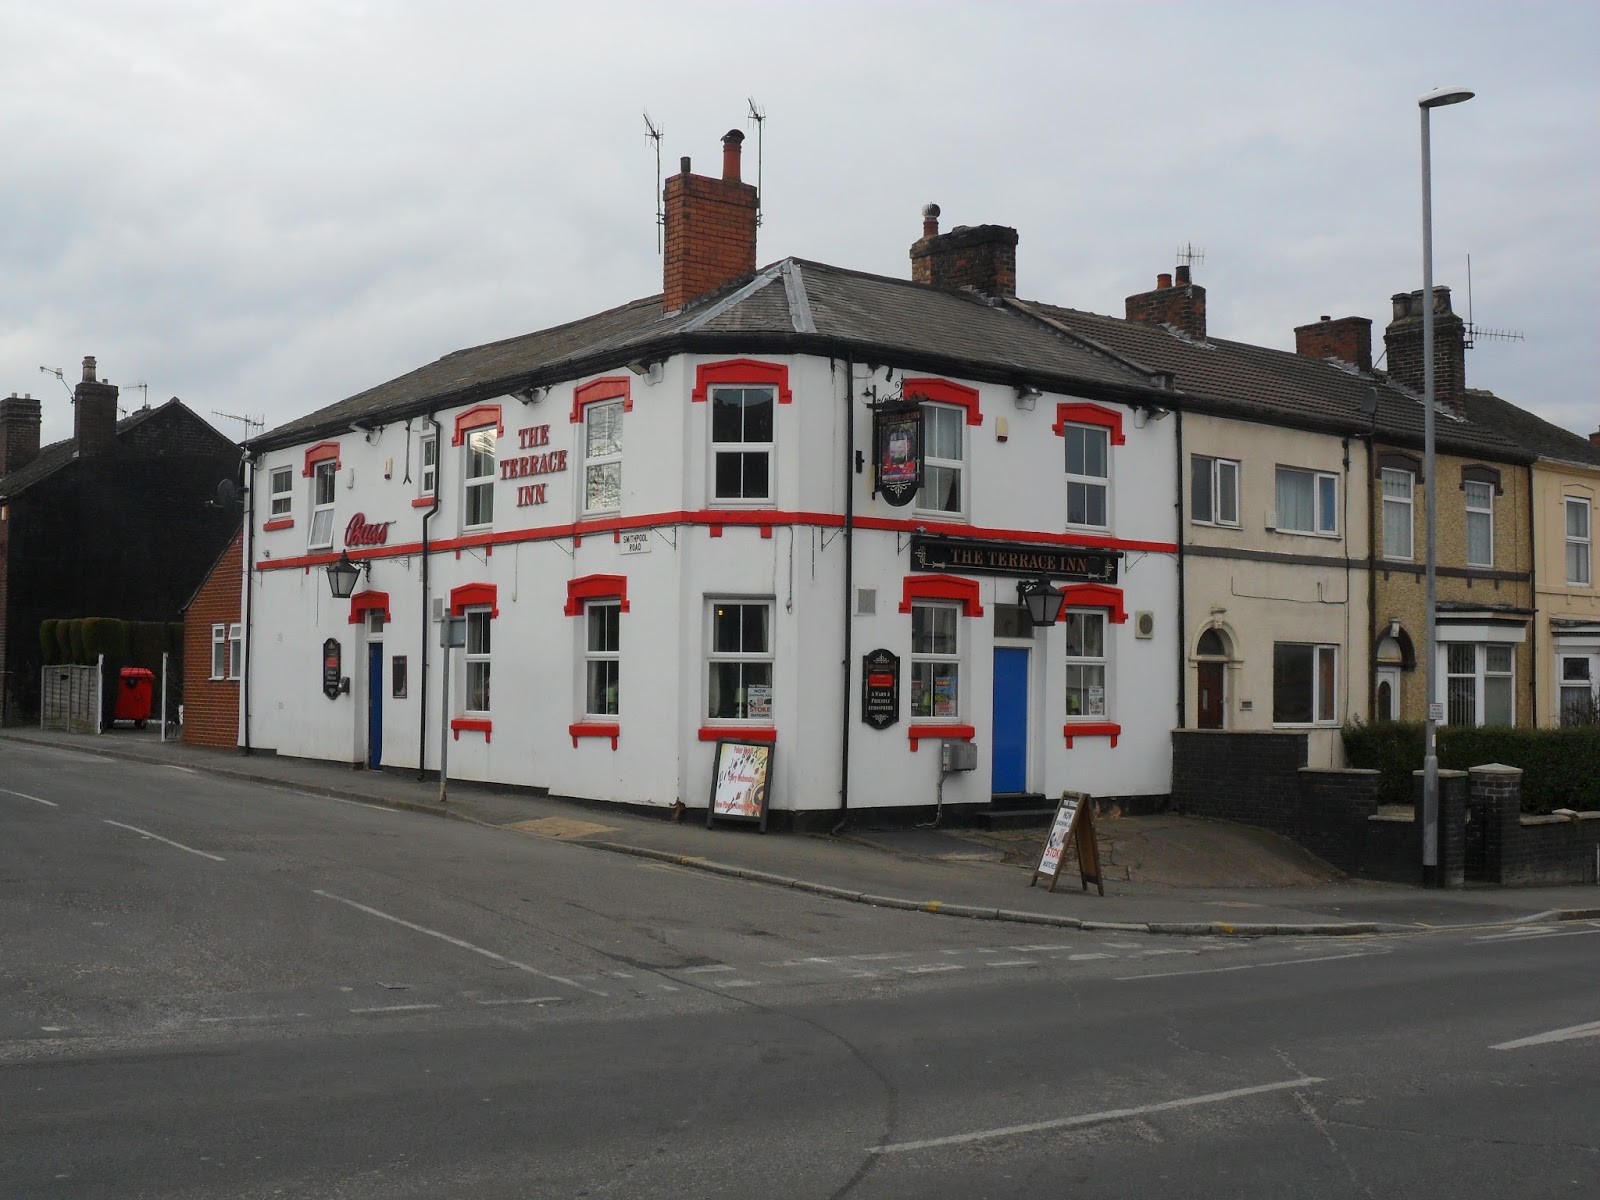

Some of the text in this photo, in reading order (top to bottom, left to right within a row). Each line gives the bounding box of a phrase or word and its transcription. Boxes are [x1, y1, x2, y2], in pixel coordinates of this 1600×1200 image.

[518, 424, 550, 449] THE
[500, 450, 568, 480] TERRACE
[517, 483, 547, 507] INN
[344, 512, 388, 546] Bass
[623, 533, 648, 543] SMITHPOOL
[629, 543, 642, 551] ROAD
[951, 549, 1088, 572] THE TERRACE INN
[1063, 811, 1073, 820] NOW
[1045, 848, 1061, 858] STOK
